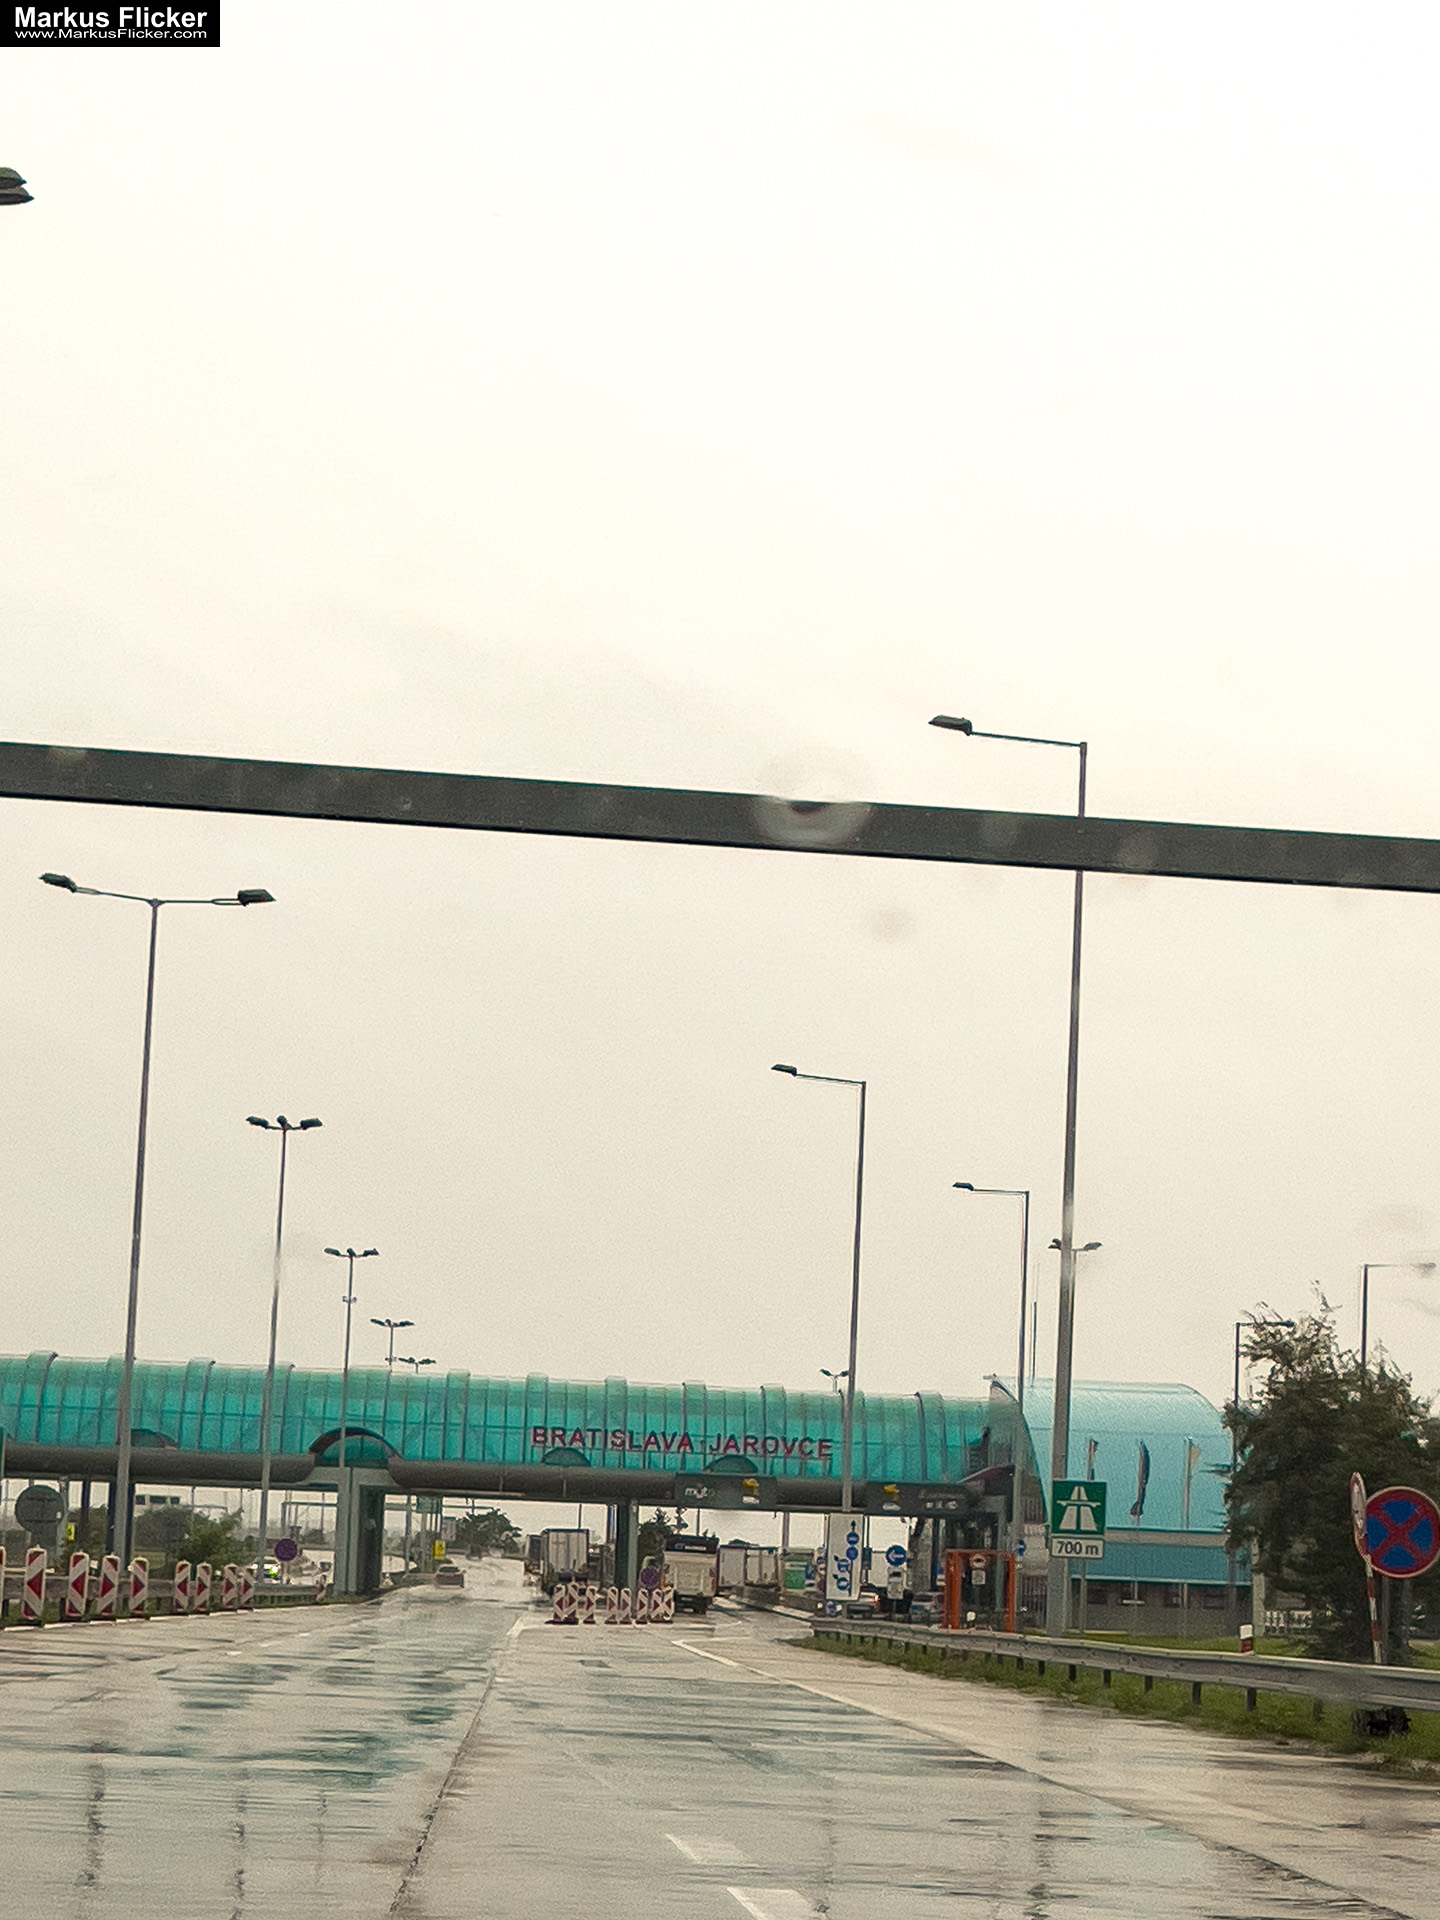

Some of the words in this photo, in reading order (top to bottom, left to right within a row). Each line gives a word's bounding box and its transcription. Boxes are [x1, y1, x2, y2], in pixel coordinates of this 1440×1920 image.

[531, 1425, 694, 1454] BRATISLAVA
[708, 1432, 833, 1461] JAROVCE
[1056, 1540, 1083, 1555] 700
[1085, 1544, 1099, 1555] m
